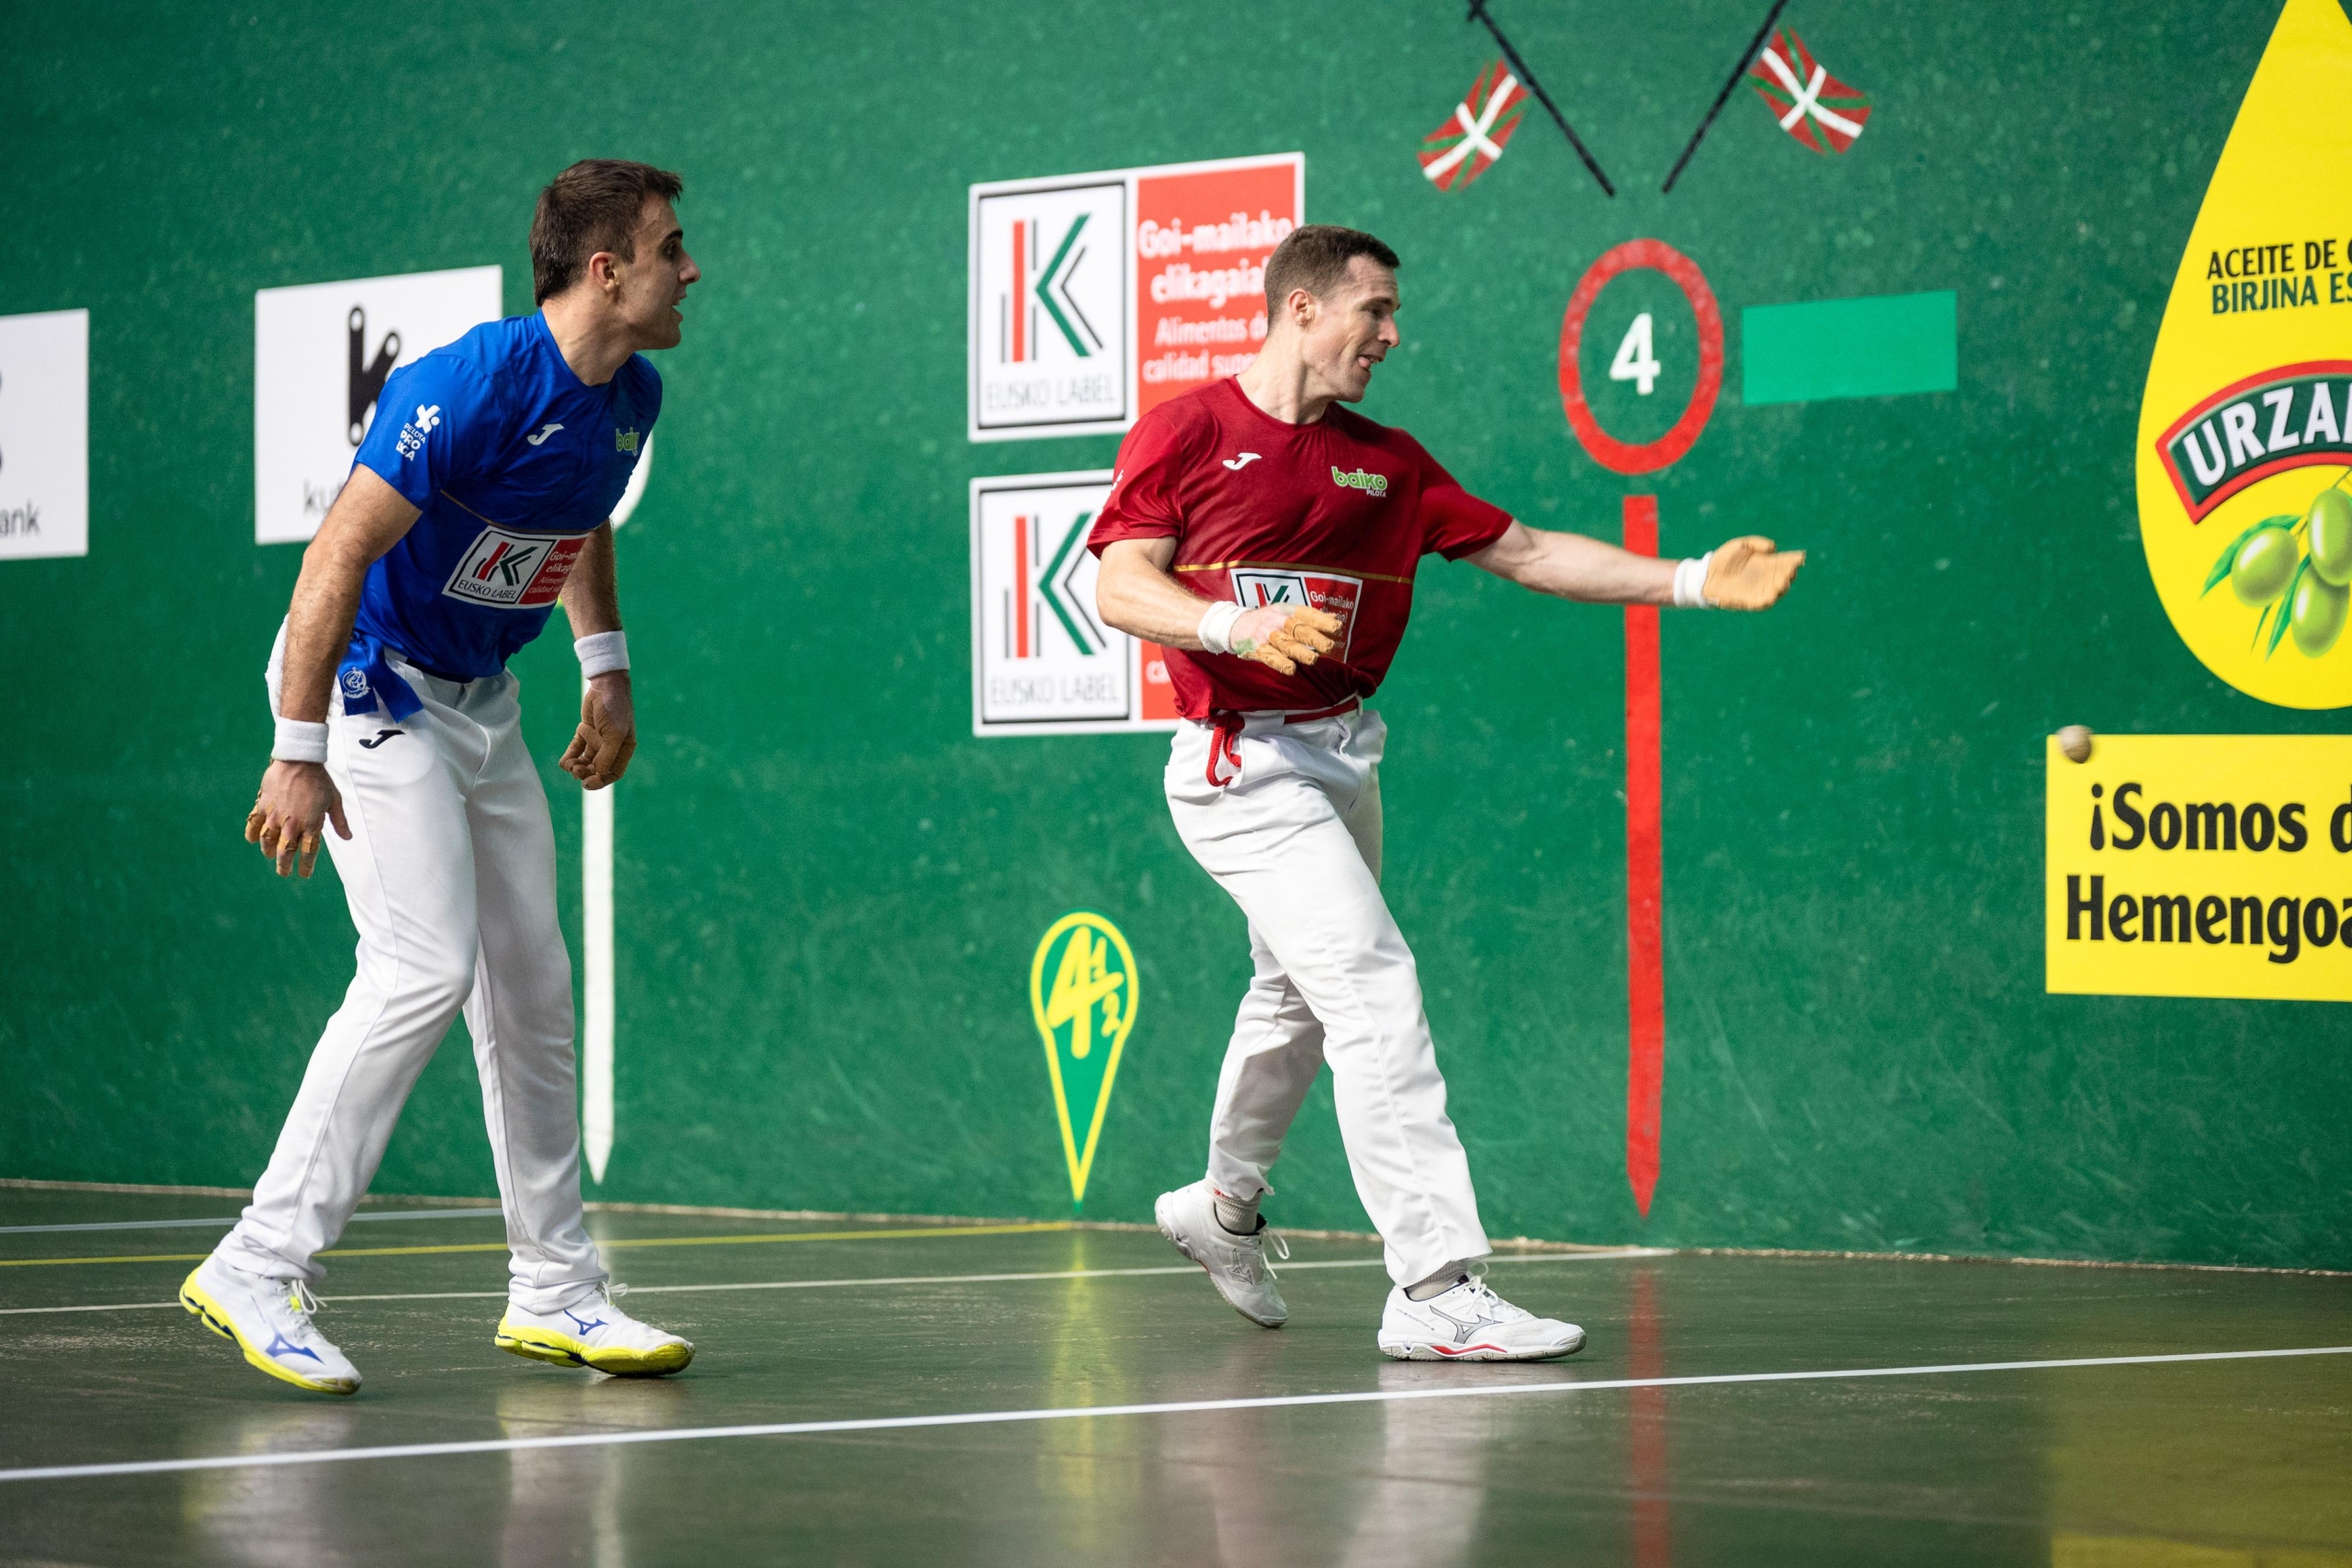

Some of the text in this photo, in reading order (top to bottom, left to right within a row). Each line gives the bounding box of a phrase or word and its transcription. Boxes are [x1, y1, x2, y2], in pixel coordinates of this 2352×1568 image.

[1138, 209, 1293, 259] Goi-mailako
[2207, 243, 2295, 280] ACEITE
[2304, 238, 2338, 271] DE
[2211, 275, 2319, 315] BIRJINA
[1609, 311, 1661, 395] 4
[987, 374, 1114, 409] EUSKO LABEL
[400, 430, 422, 450] PRO
[1330, 465, 1388, 491] baiko
[458, 579, 517, 599] EUSKO LABEL
[1309, 590, 1354, 610] Goi-mailako
[990, 672, 1119, 705] EUSKO LABEL
[2089, 782, 2309, 852] ¡Somos
